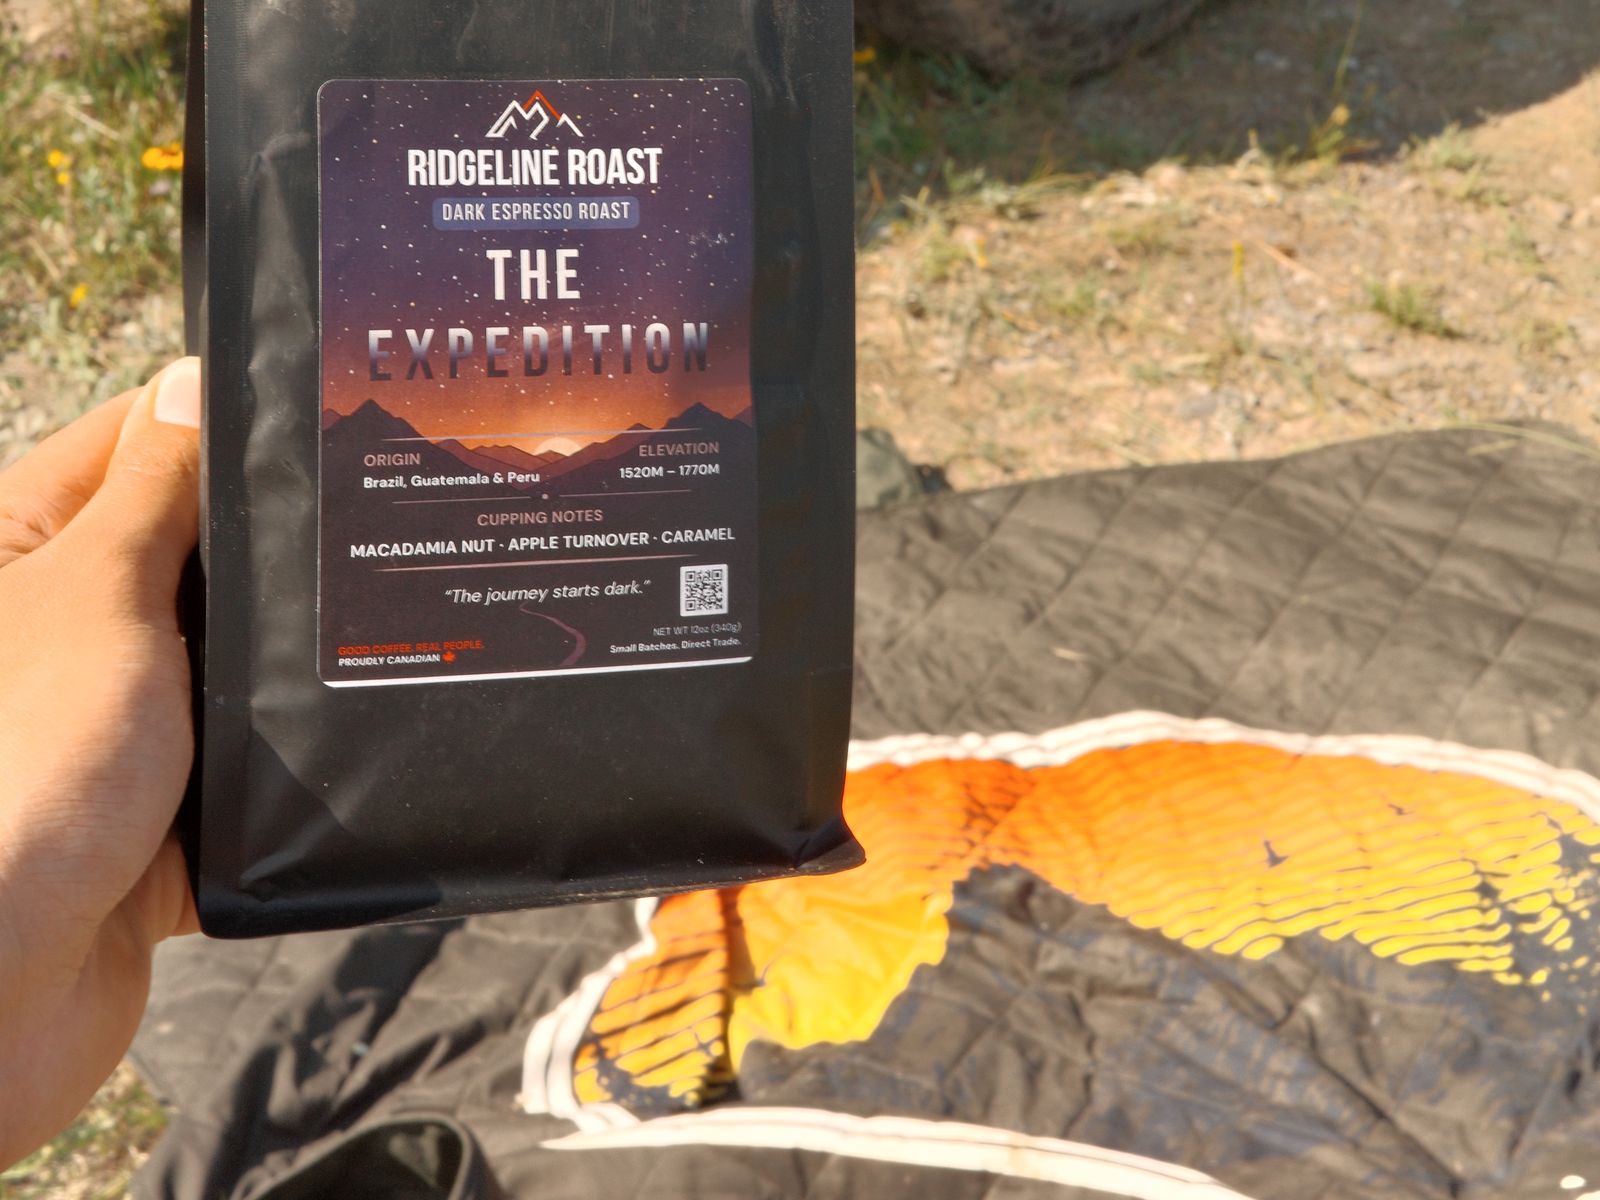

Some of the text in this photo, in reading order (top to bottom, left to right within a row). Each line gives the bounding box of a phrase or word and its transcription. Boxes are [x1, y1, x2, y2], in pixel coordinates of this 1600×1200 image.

[408, 148, 663, 186] RIDGELINE ROAST
[442, 202, 630, 221] DARK ESPRESSO ROAST
[486, 249, 580, 300] THE
[368, 322, 708, 381] EXPEDITION
[639, 442, 719, 457] ELEVATION
[364, 452, 421, 467] ORIGIN
[363, 471, 540, 489] Brazil, Guatemala & Peru
[619, 465, 664, 479] 1520M
[679, 463, 720, 477] 1770M
[477, 509, 603, 527] CUPPING NOTES
[350, 541, 456, 558] MACADAMIA
[461, 539, 495, 554] NUT
[508, 535, 560, 551] APPLE
[563, 532, 649, 548] TURNOVER
[661, 527, 735, 544] CARAMEL
[484, 588, 548, 605] journey
[552, 584, 599, 598] starts
[653, 622, 742, 636] NET WT 12oz (340g)
[338, 646, 370, 656] GOOD
[416, 642, 441, 651] REAL
[610, 637, 740, 653] Small Batches. Direct Trade.
[338, 654, 440, 667] PROUDLY CANADIAN
